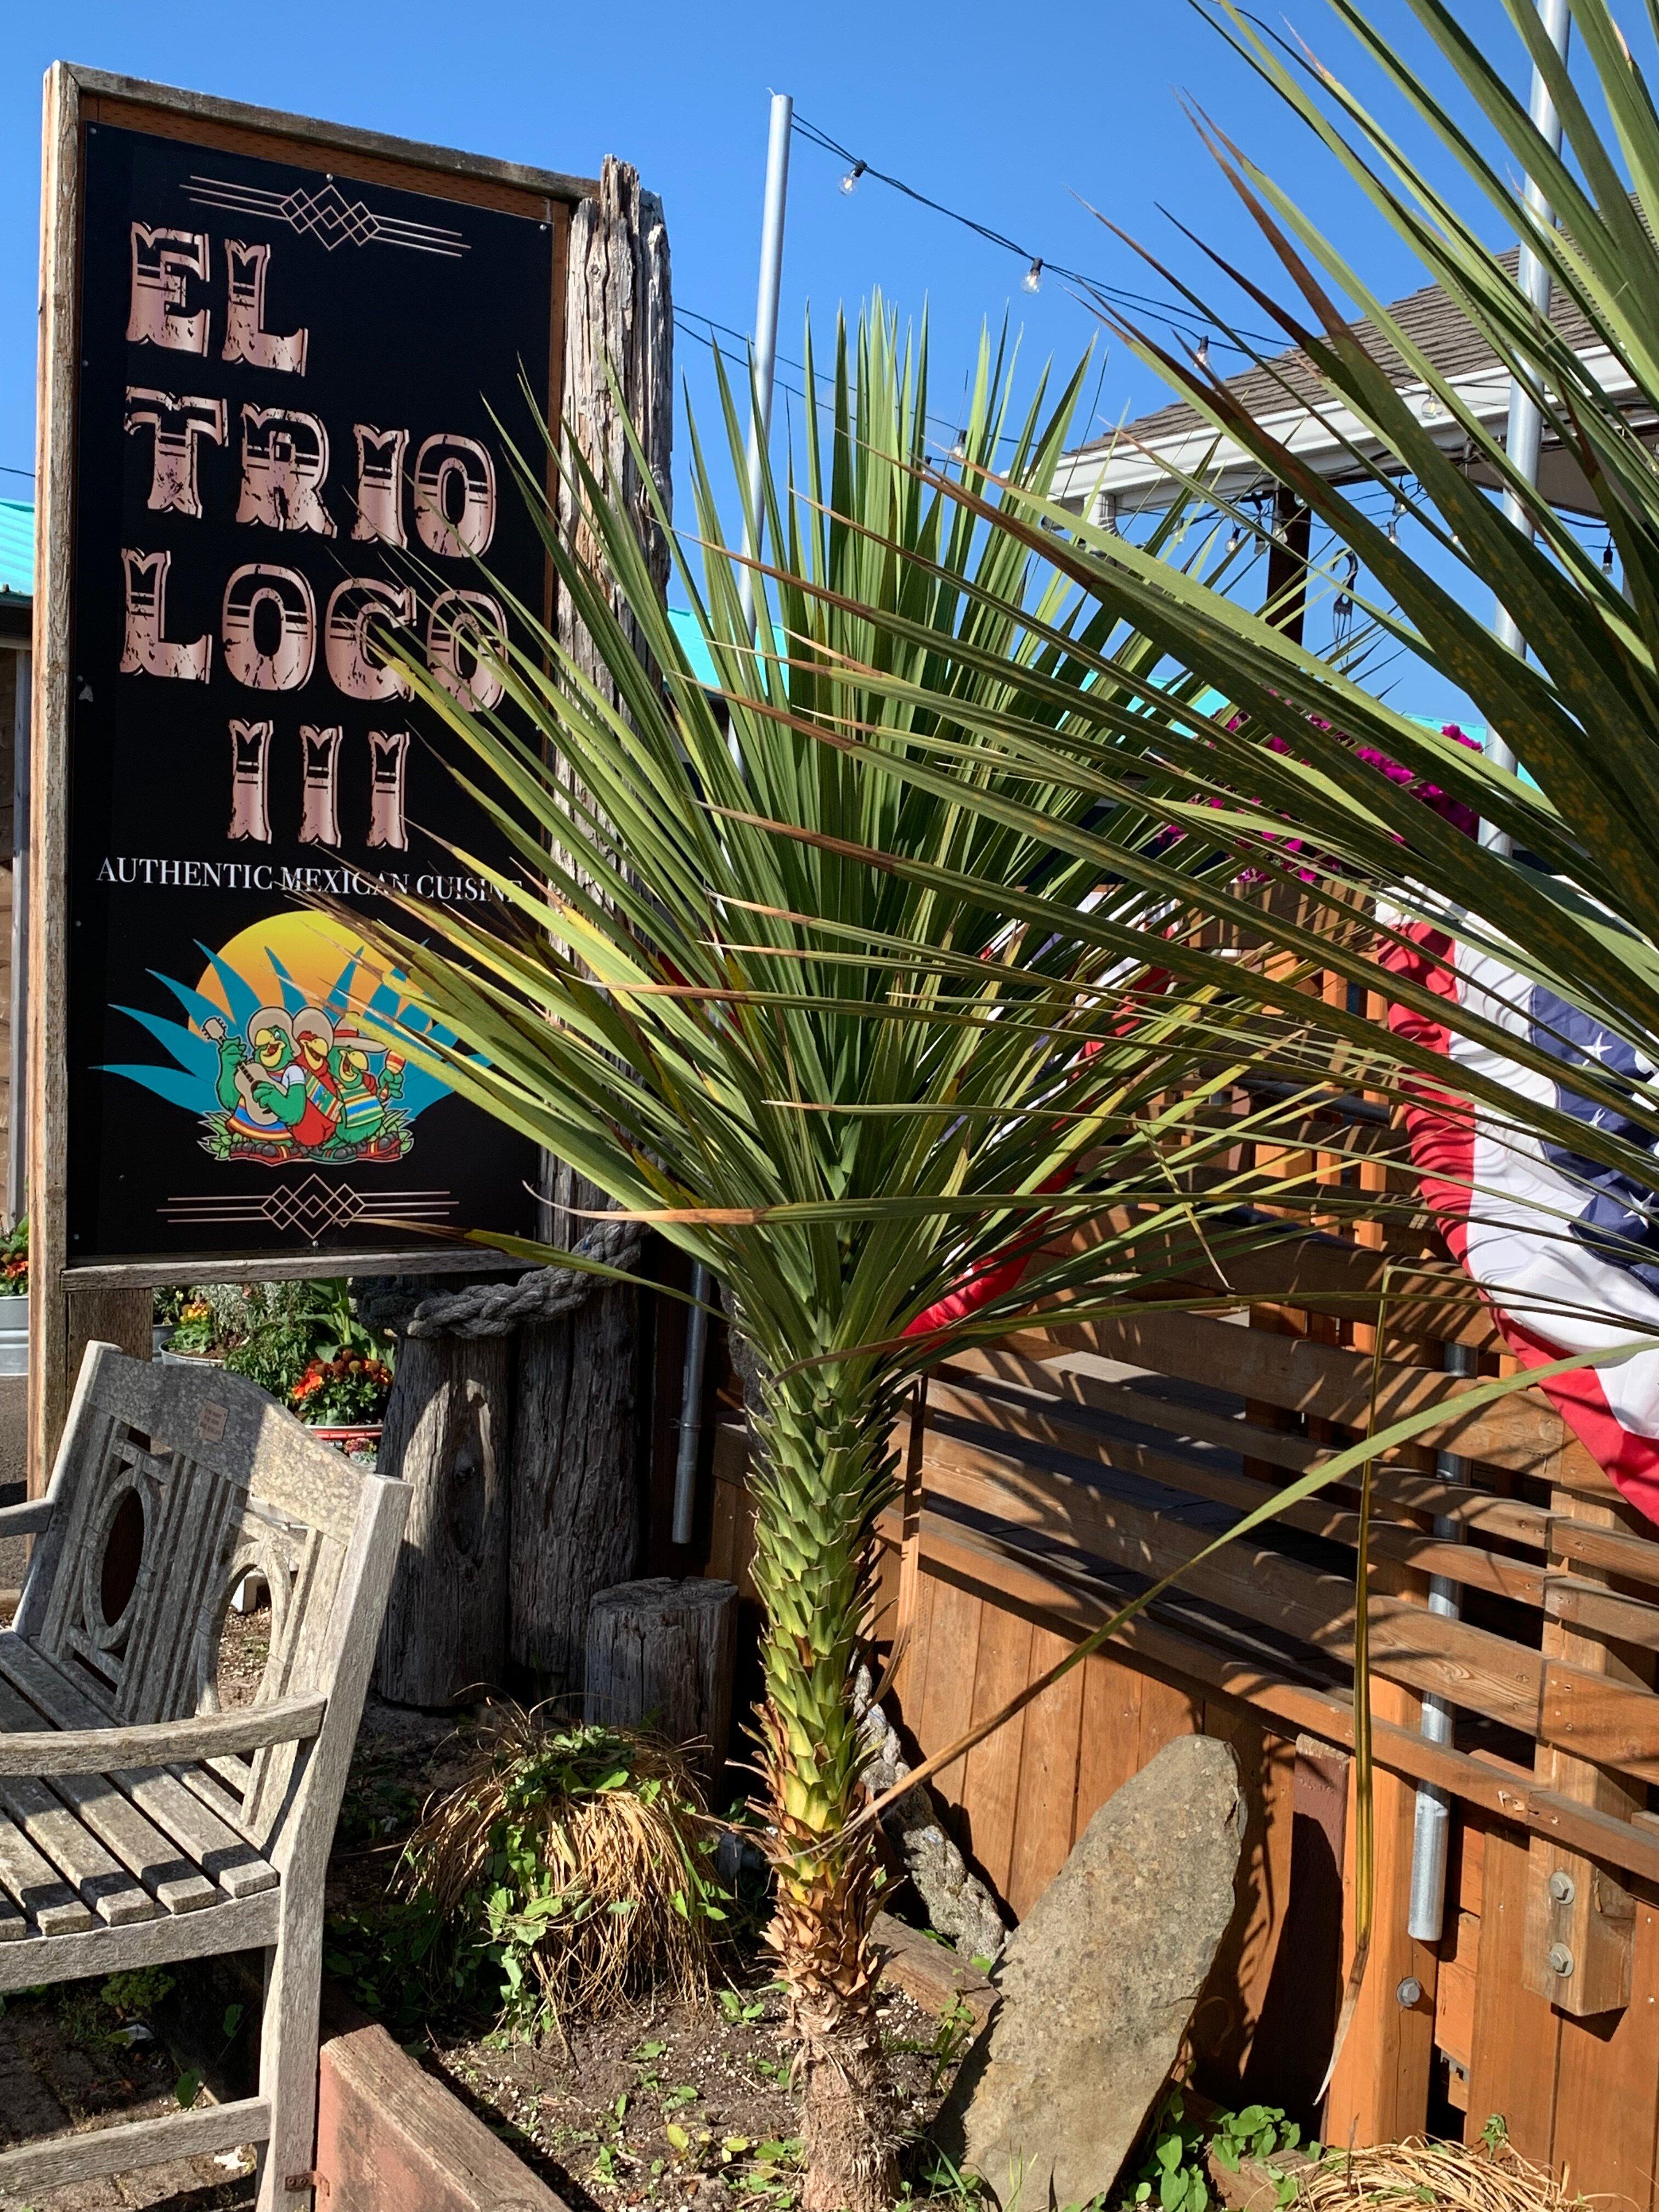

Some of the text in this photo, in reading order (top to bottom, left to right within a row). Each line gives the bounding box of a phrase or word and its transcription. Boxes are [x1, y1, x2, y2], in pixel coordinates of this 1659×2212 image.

[126, 222, 308, 377] EL
[124, 386, 496, 557] TRIO
[119, 548, 509, 713] LOCO
[227, 719, 410, 852] III
[97, 857, 273, 890] AUTHENTIC
